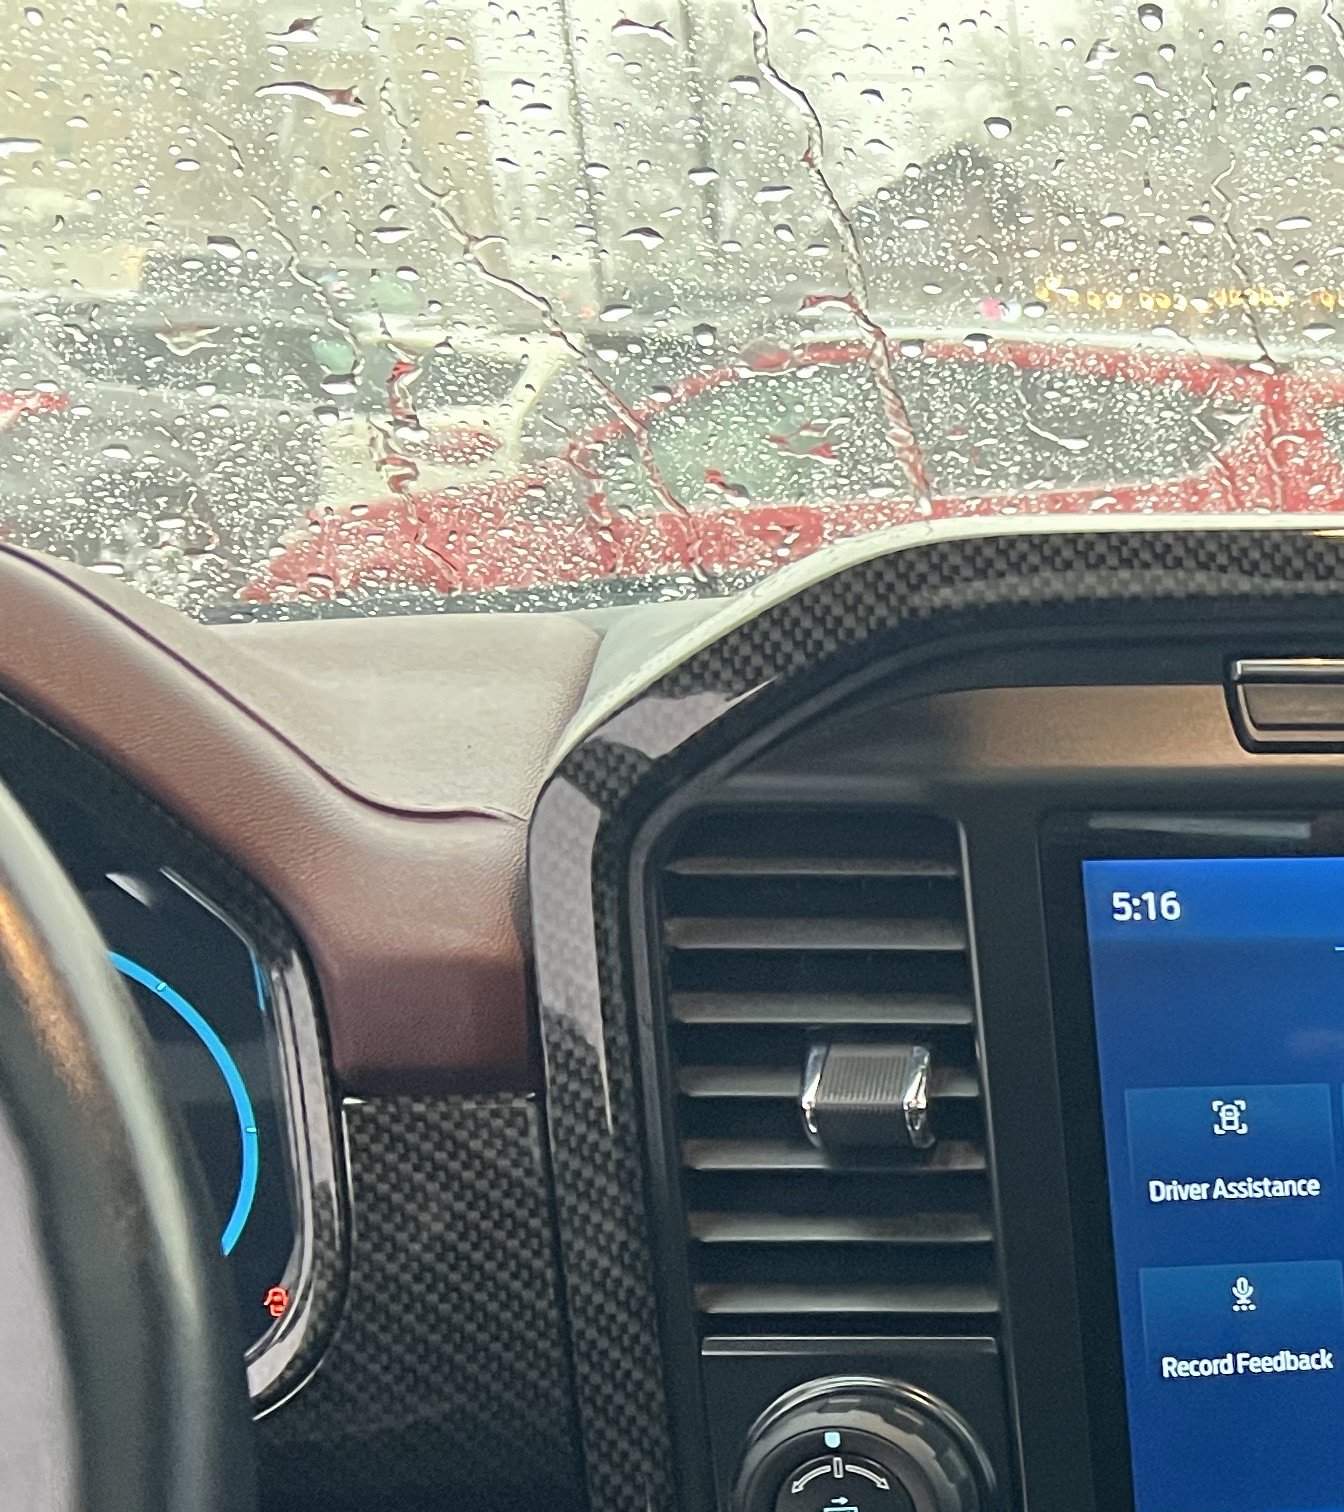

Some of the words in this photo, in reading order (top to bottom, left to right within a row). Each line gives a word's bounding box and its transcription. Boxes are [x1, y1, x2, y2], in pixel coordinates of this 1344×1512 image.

[1111, 891, 1181, 921] 5:16
[1149, 1180, 1210, 1202] Driver
[1212, 1175, 1321, 1200] Assistance
[1162, 1352, 1234, 1378] Record
[1236, 1348, 1334, 1374] Feedback
